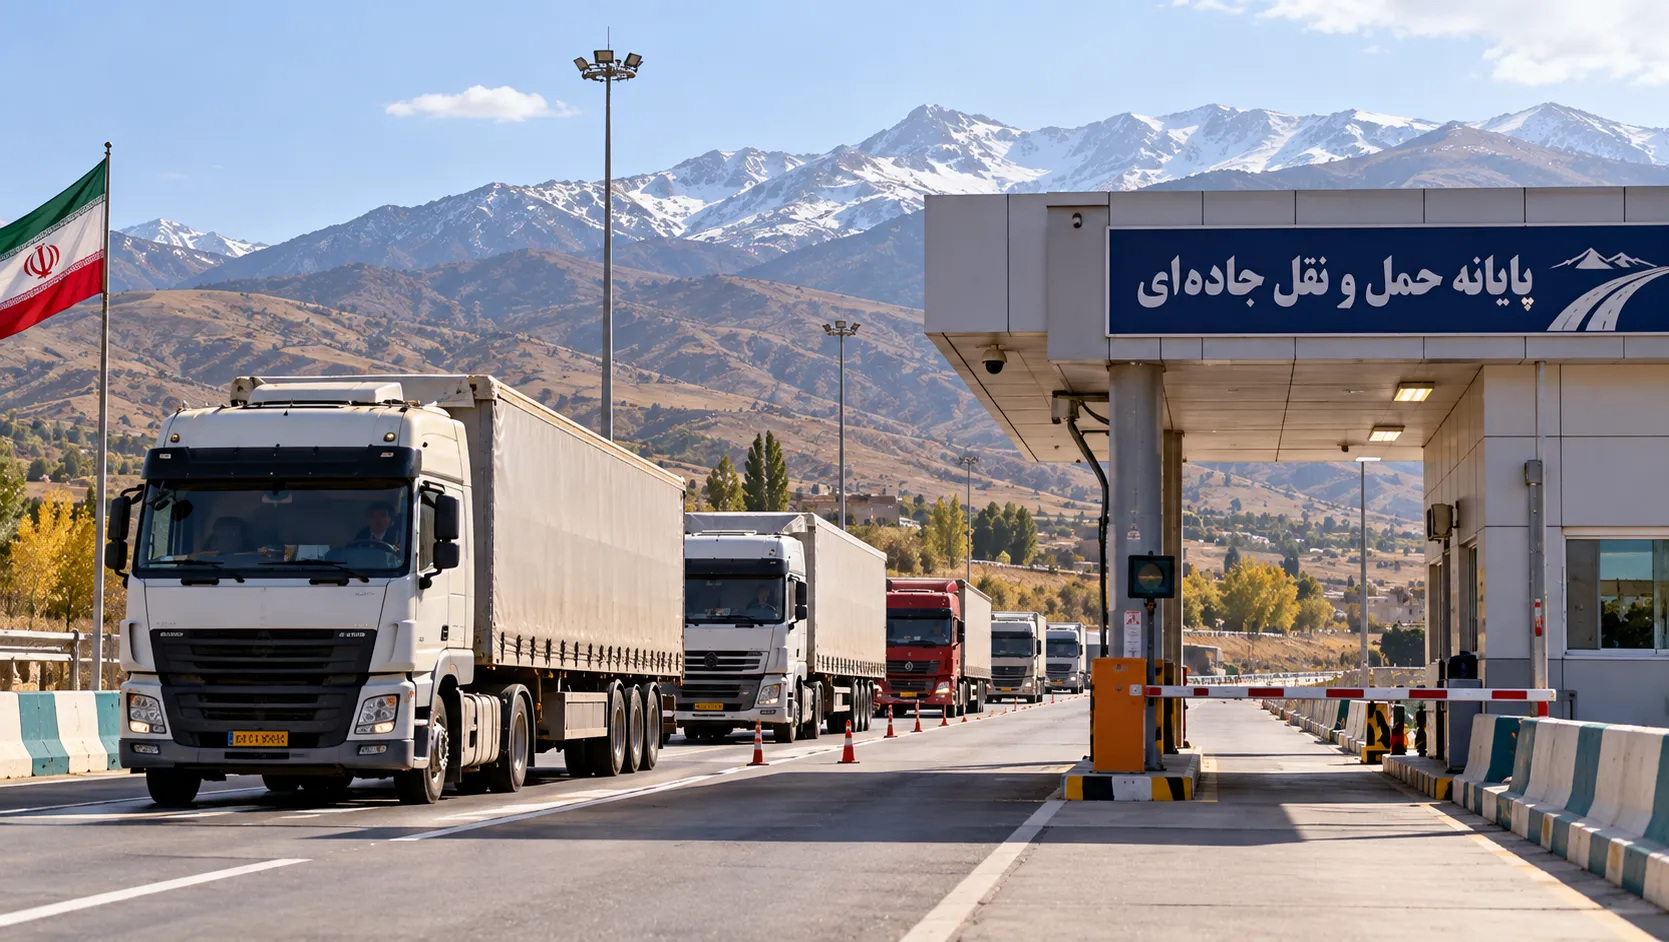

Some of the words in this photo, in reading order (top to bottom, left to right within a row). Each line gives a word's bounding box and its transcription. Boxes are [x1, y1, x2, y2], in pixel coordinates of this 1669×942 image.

[1273, 255, 1329, 307] نقل
[1336, 273, 1356, 309] و
[1365, 255, 1443, 307] حمل
[1452, 254, 1535, 311] پایانه
